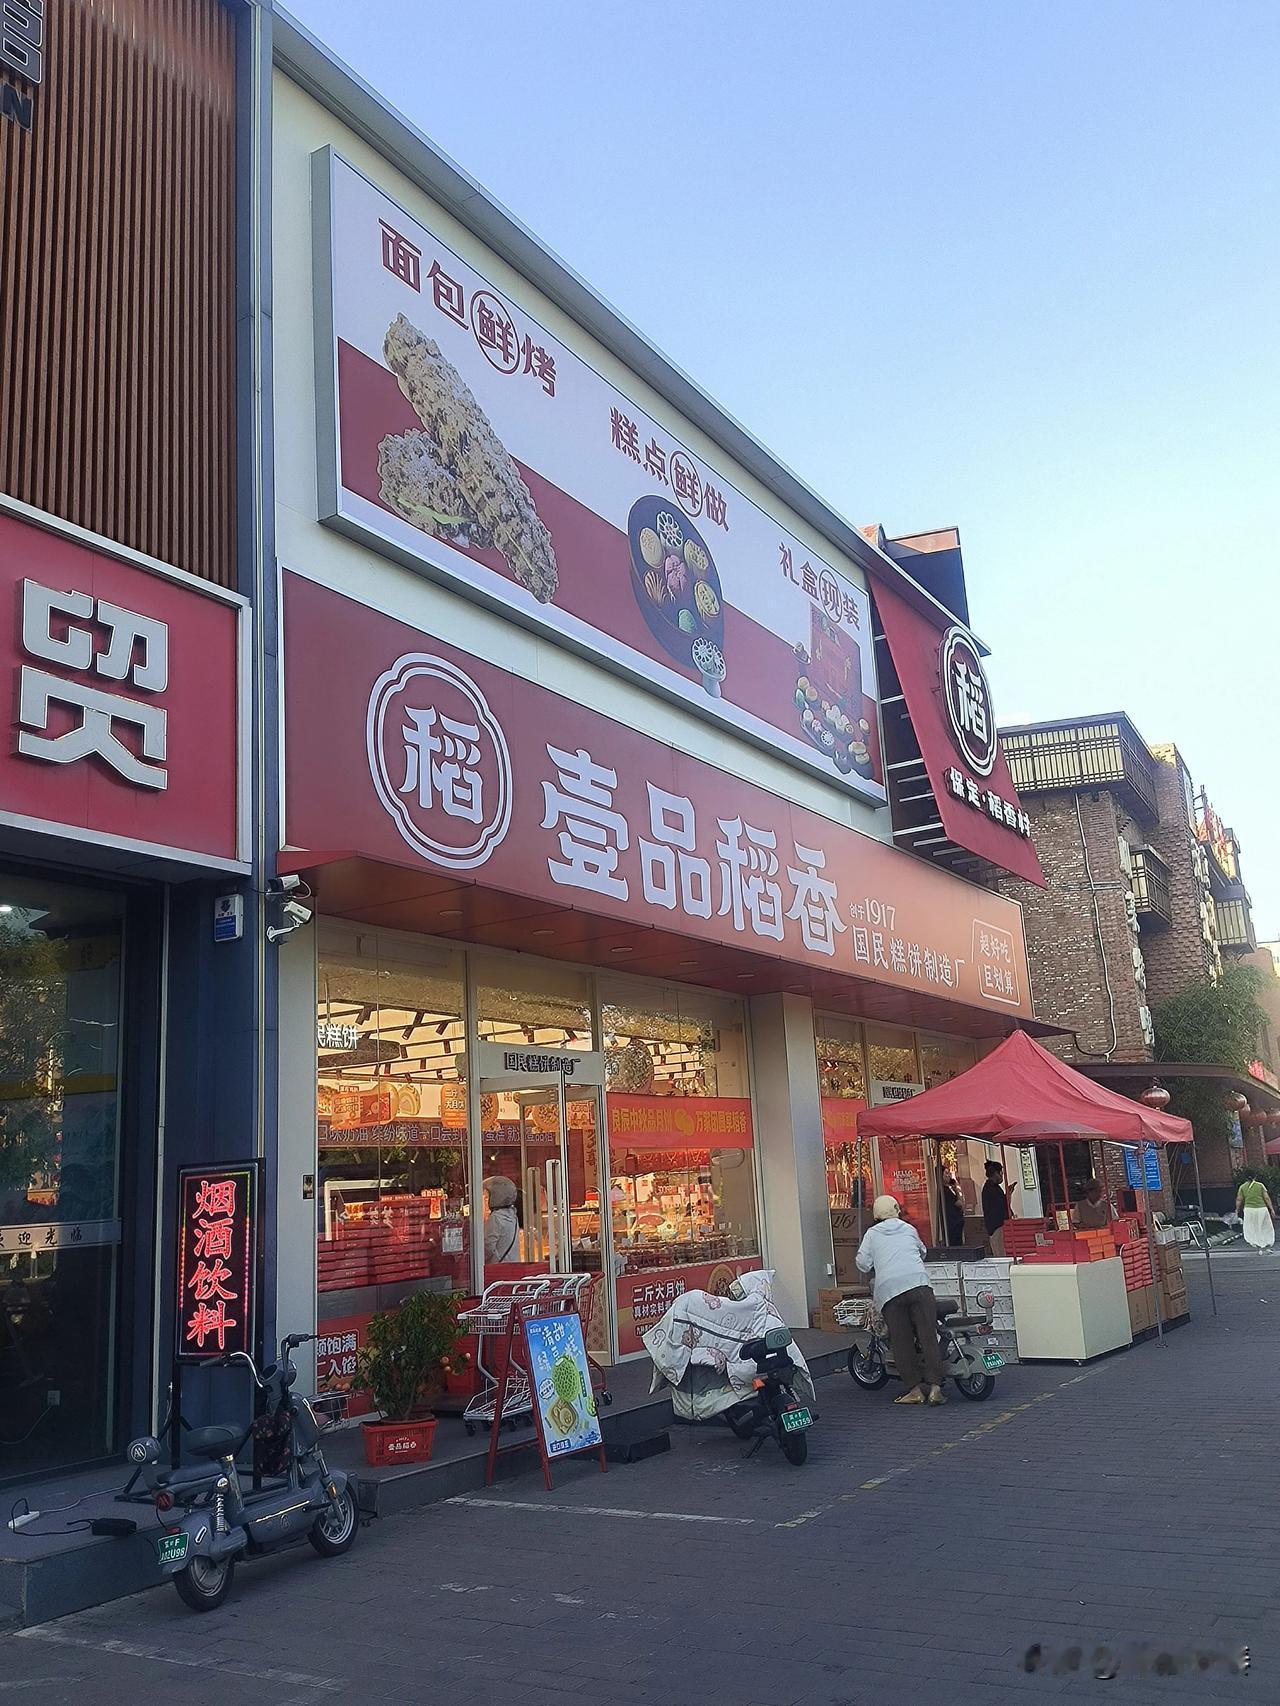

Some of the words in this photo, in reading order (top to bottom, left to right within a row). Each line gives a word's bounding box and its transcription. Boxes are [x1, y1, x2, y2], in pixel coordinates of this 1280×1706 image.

[378, 217, 557, 398] 面包鲜烤
[608, 406, 730, 532] 糕点鲜做
[777, 541, 860, 631] 礼盒现装
[954, 660, 988, 744] 稻
[399, 704, 484, 824] 稻
[539, 742, 848, 957] 壹品稻香
[852, 924, 966, 989] 国民糕饼制造厂
[187, 1180, 238, 1350] 烟酒饮料
[633, 1279, 685, 1303] 二斤大月饼
